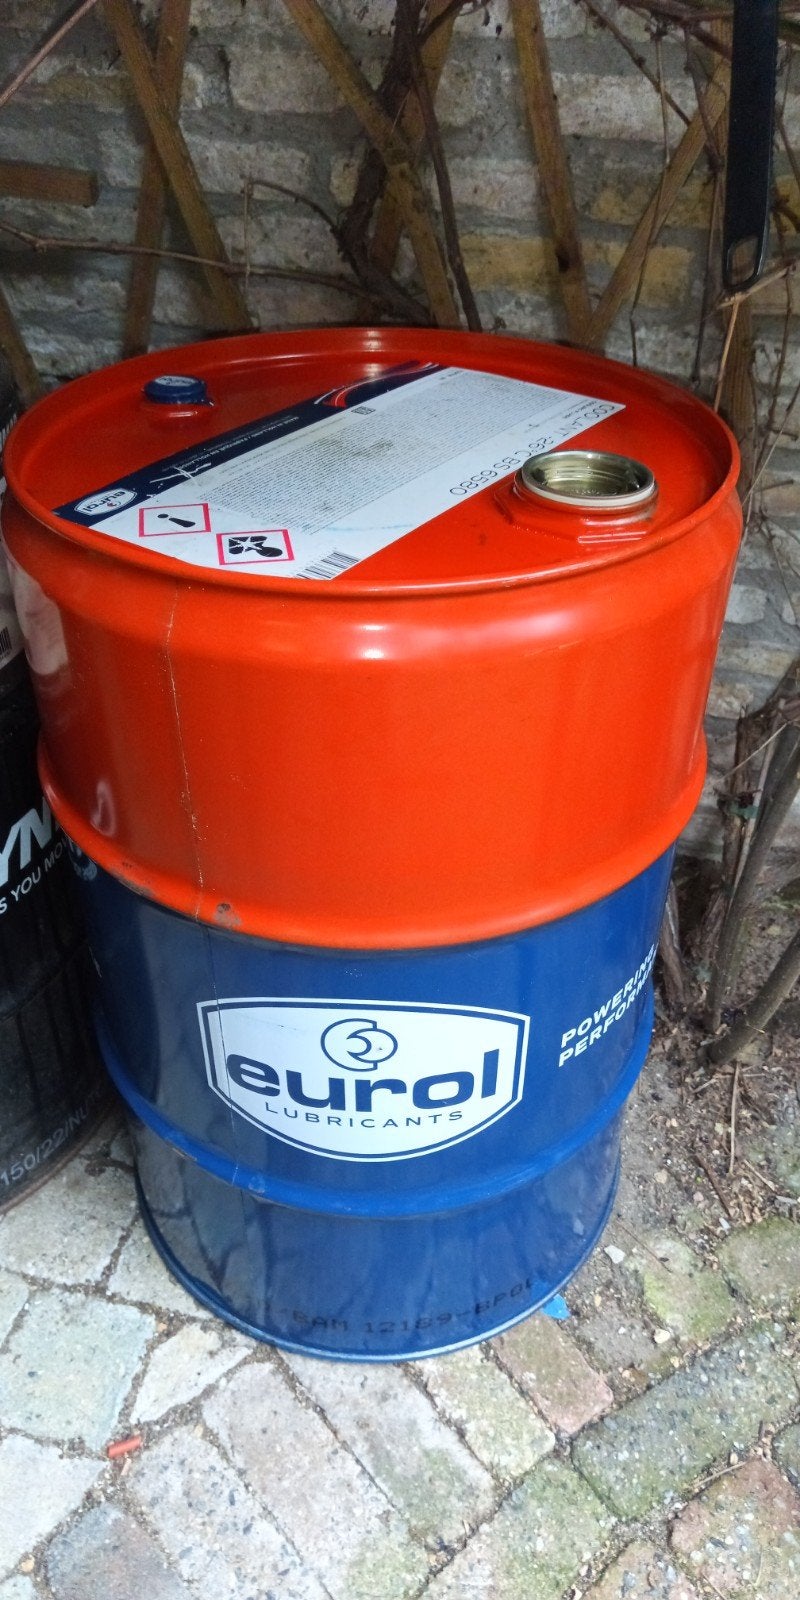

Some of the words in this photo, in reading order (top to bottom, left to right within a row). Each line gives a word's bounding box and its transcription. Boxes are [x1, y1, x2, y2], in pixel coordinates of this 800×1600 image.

[493, 456, 521, 471] BS
[449, 468, 499, 496] 6580
[82, 491, 126, 512] eurol
[10, 867, 42, 902] YOU
[561, 943, 655, 1049] POWERING
[226, 1048, 500, 1113] eurol
[265, 1101, 463, 1129] LUBRICANTS
